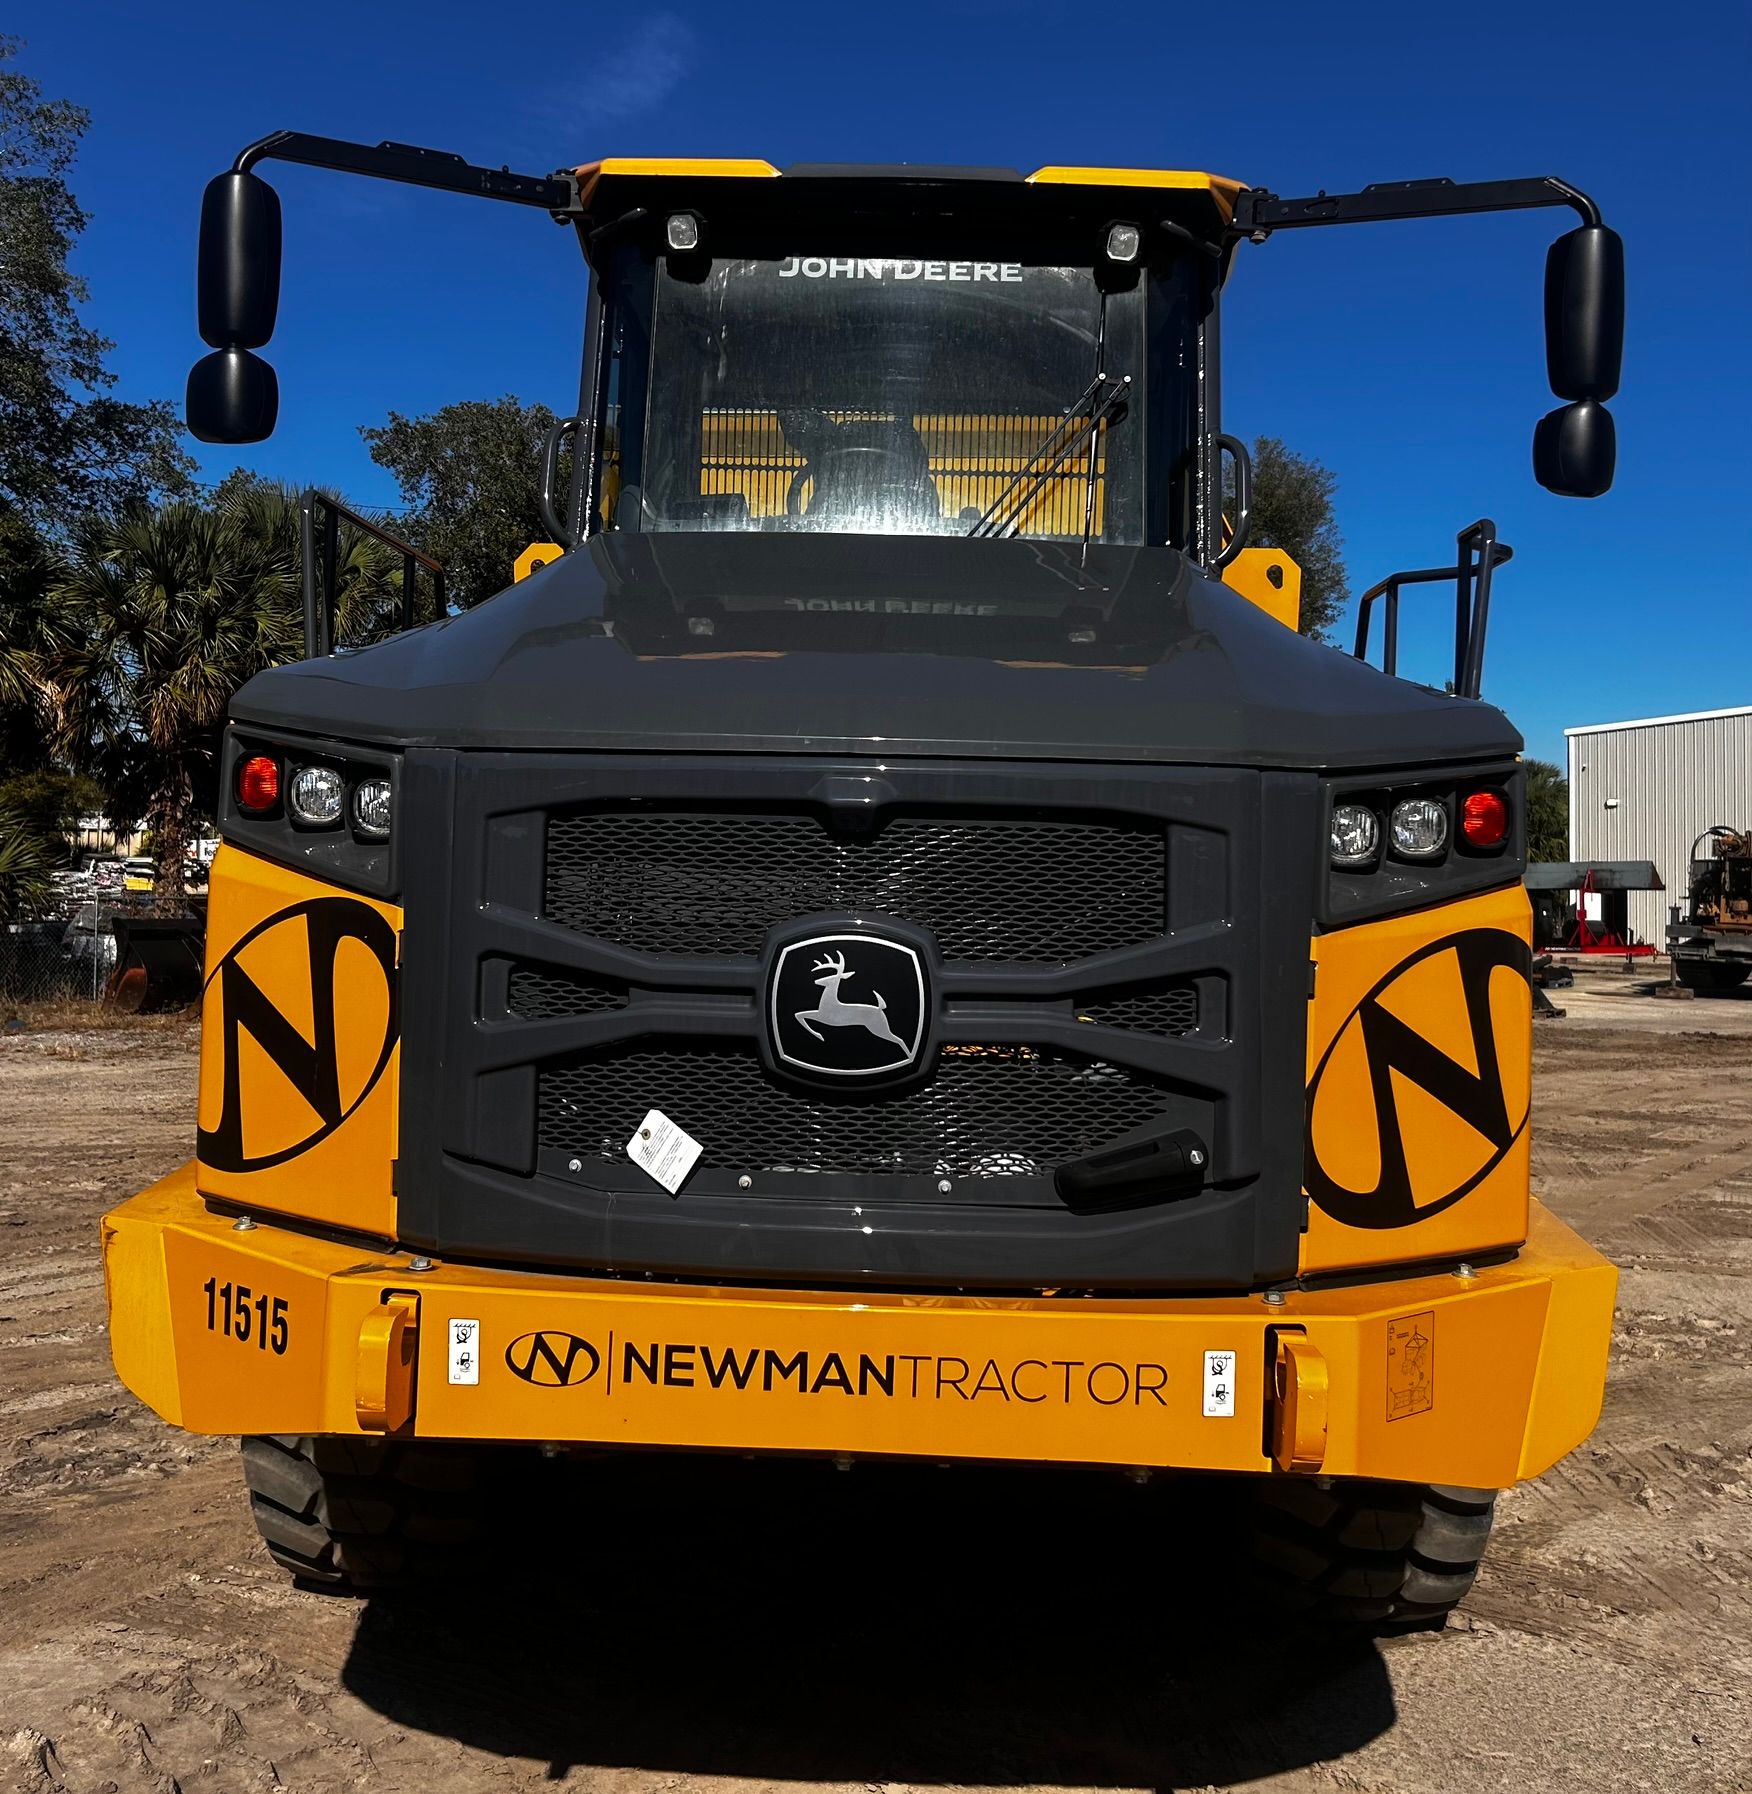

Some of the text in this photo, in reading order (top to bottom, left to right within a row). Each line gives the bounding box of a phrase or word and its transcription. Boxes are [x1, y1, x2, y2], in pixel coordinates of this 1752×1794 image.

[779, 256, 1023, 282] JOHN DEERE
[203, 1277, 289, 1356] 11515
